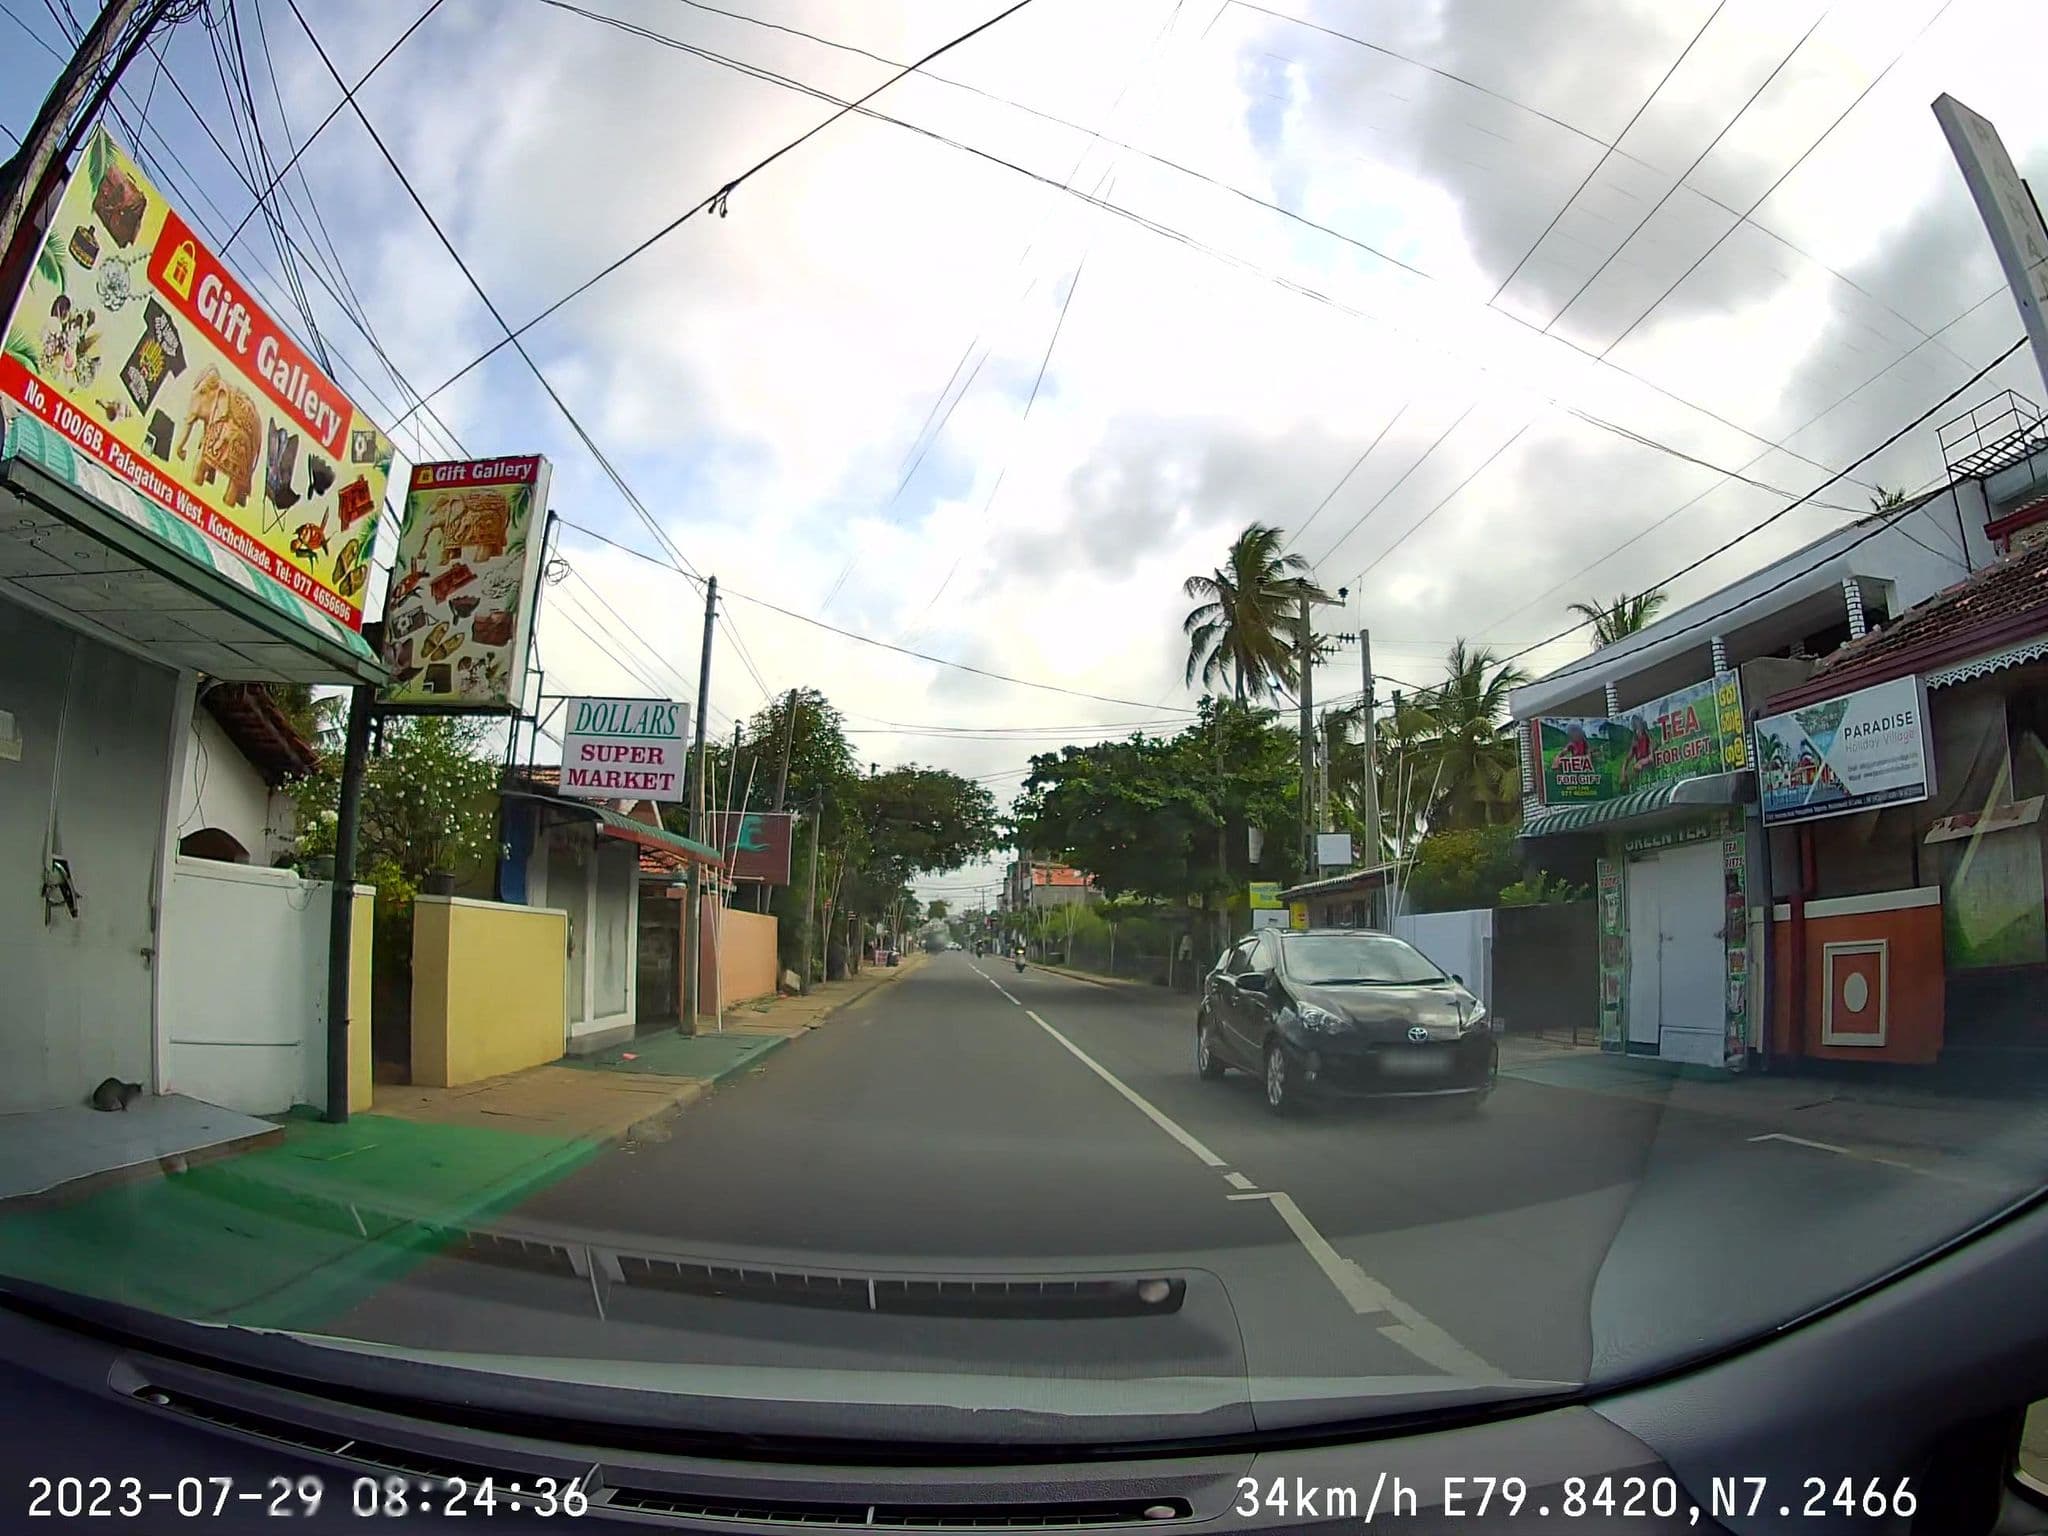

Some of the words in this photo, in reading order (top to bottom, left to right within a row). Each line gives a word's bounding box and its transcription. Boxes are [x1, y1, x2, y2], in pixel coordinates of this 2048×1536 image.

[197, 273, 252, 354] Gift
[257, 335, 342, 447] Gallery
[435, 464, 467, 482] Gift
[472, 461, 532, 480] Gallery
[24, 379, 47, 415] No.
[53, 402, 105, 458] 100/6B,
[108, 442, 174, 506] Palagatura
[176, 489, 204, 528] West,
[207, 513, 272, 572] Kochchikade.
[275, 559, 292, 584] Tel:
[293, 573, 313, 596] 077
[574, 701, 679, 735] DOLLARS
[1657, 704, 1701, 743] TEA
[1844, 711, 1913, 740] PARADISE
[1846, 735, 1879, 752] Holiday
[1883, 728, 1914, 744] Village
[580, 743, 665, 765] SUPER
[1560, 756, 1595, 773] TEA
[1655, 746, 1681, 769] FOR
[566, 768, 675, 791] MARKET
[1556, 774, 1577, 785] FOR
[1577, 774, 1601, 785] GIFT
